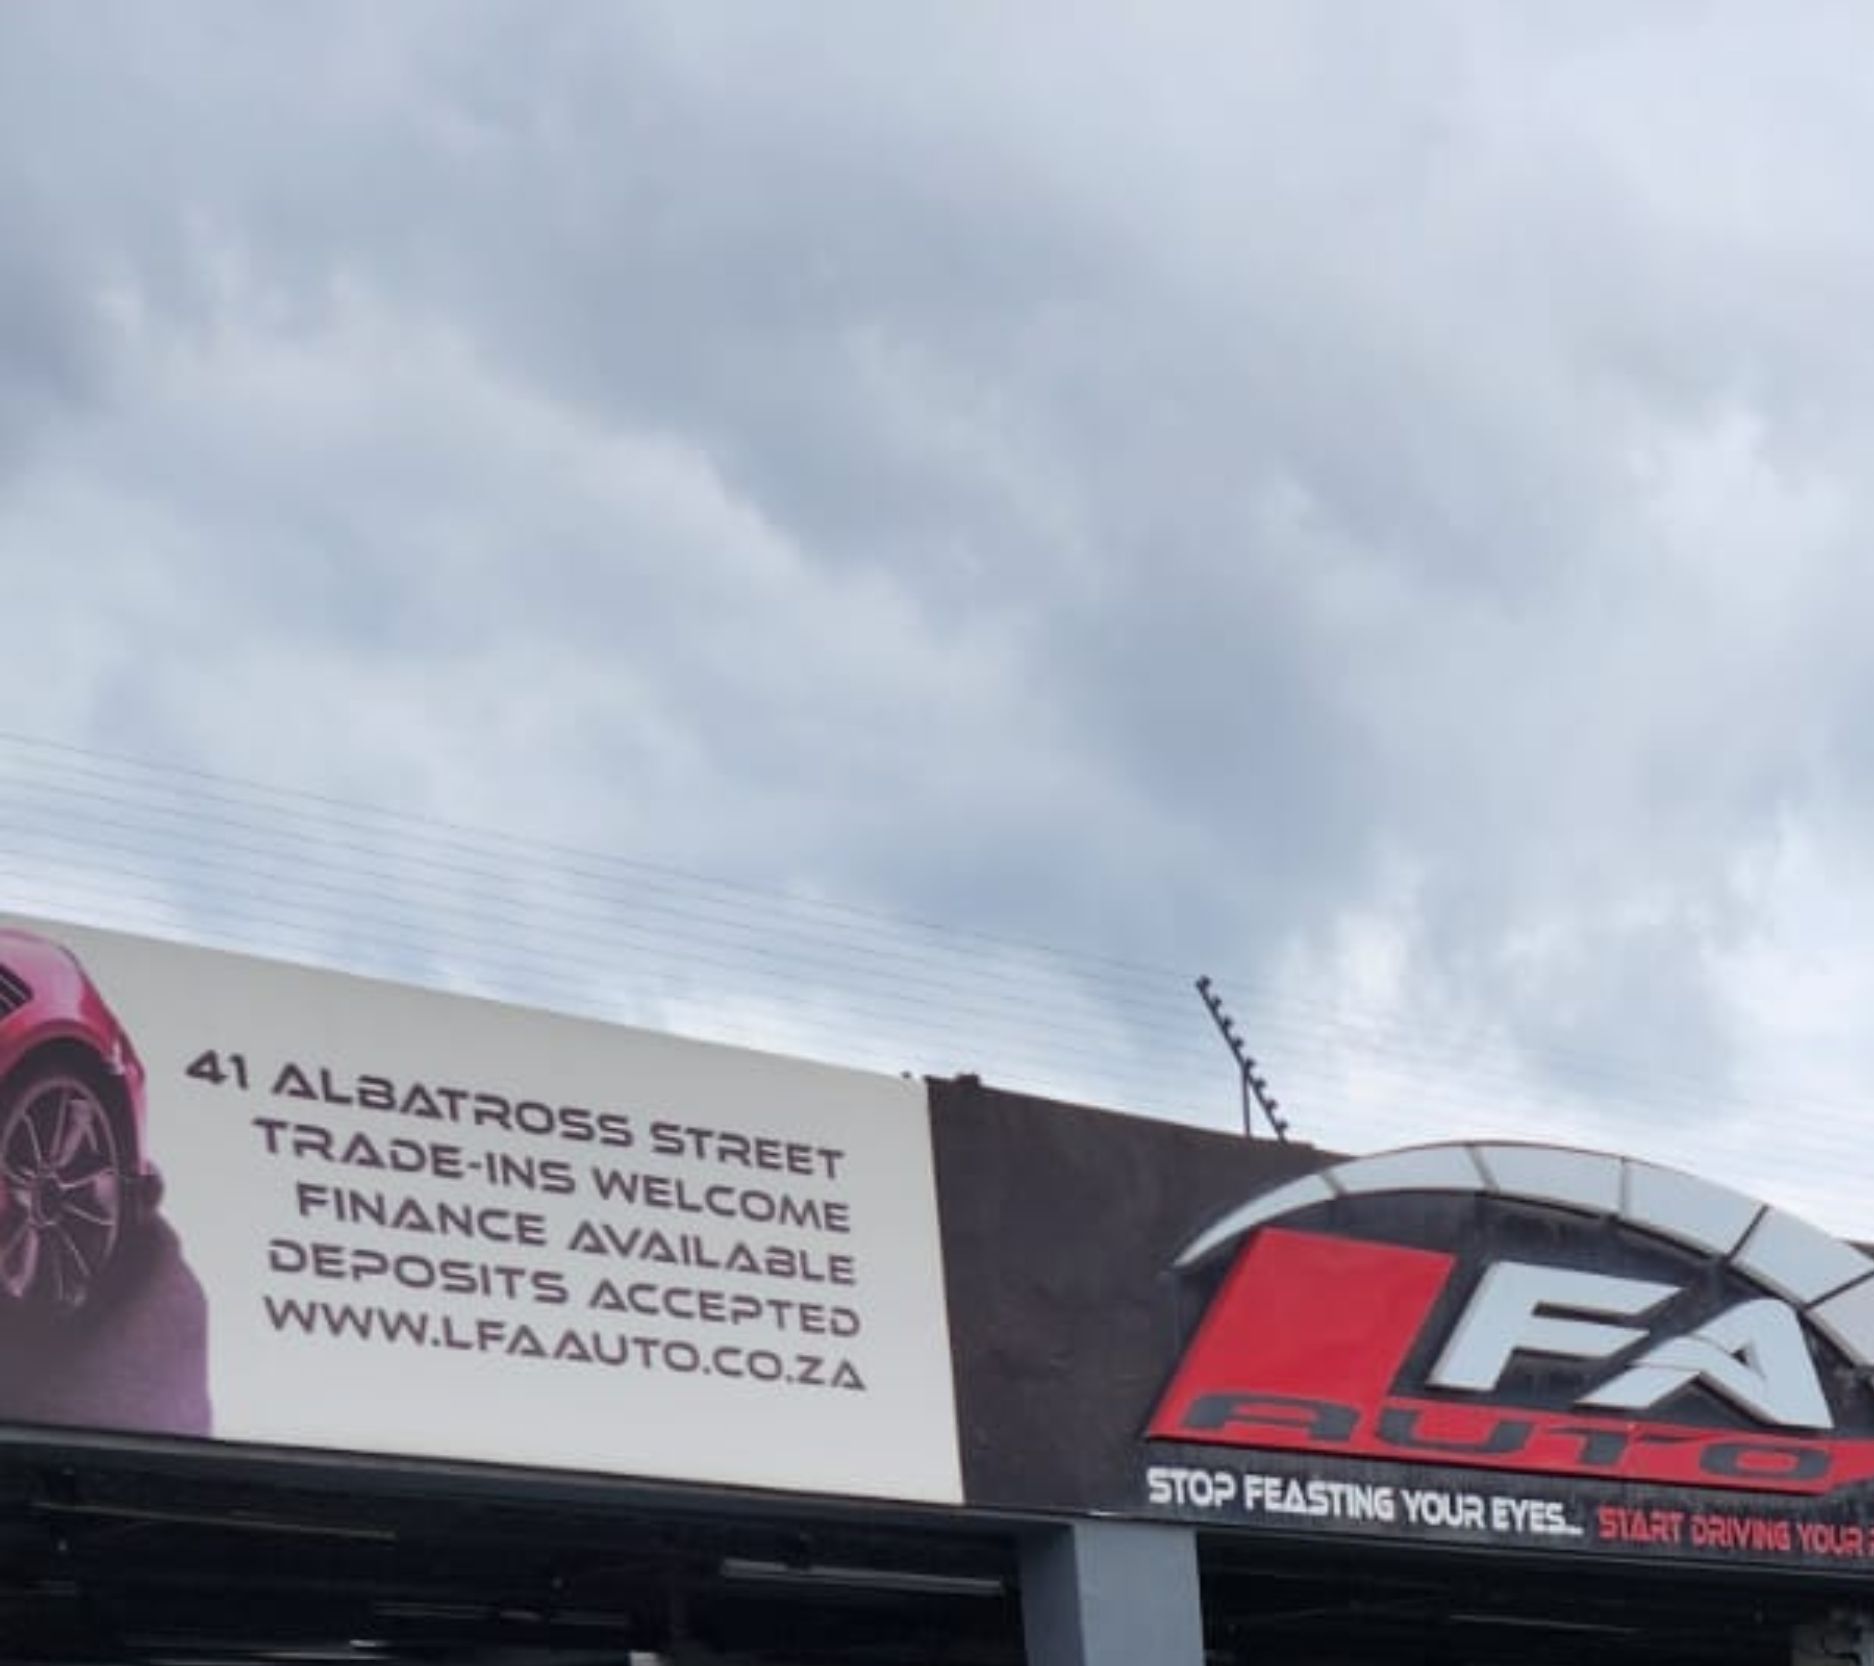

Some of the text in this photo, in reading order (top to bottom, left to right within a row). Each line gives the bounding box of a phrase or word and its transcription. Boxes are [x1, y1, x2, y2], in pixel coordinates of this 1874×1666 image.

[184, 1049, 846, 1181] 41 ALBATROSS STREET
[250, 1117, 852, 1235] TRADE-INS WELCOME
[294, 1181, 857, 1288] FINANCE AVAILABLE
[267, 1238, 861, 1339] DEPOSITS ACCEPTED
[261, 1295, 868, 1392] WWW.LFAAUTO.CO.ZA
[1181, 1391, 1835, 1481] AUTO
[1147, 1468, 1237, 1507] STOP
[1244, 1475, 1396, 1522] FEASTING
[1401, 1490, 1486, 1530] YOUR
[1599, 1505, 1683, 1543] START
[1691, 1515, 1791, 1552] DRIVING
[1798, 1523, 1865, 1555] YOUR
